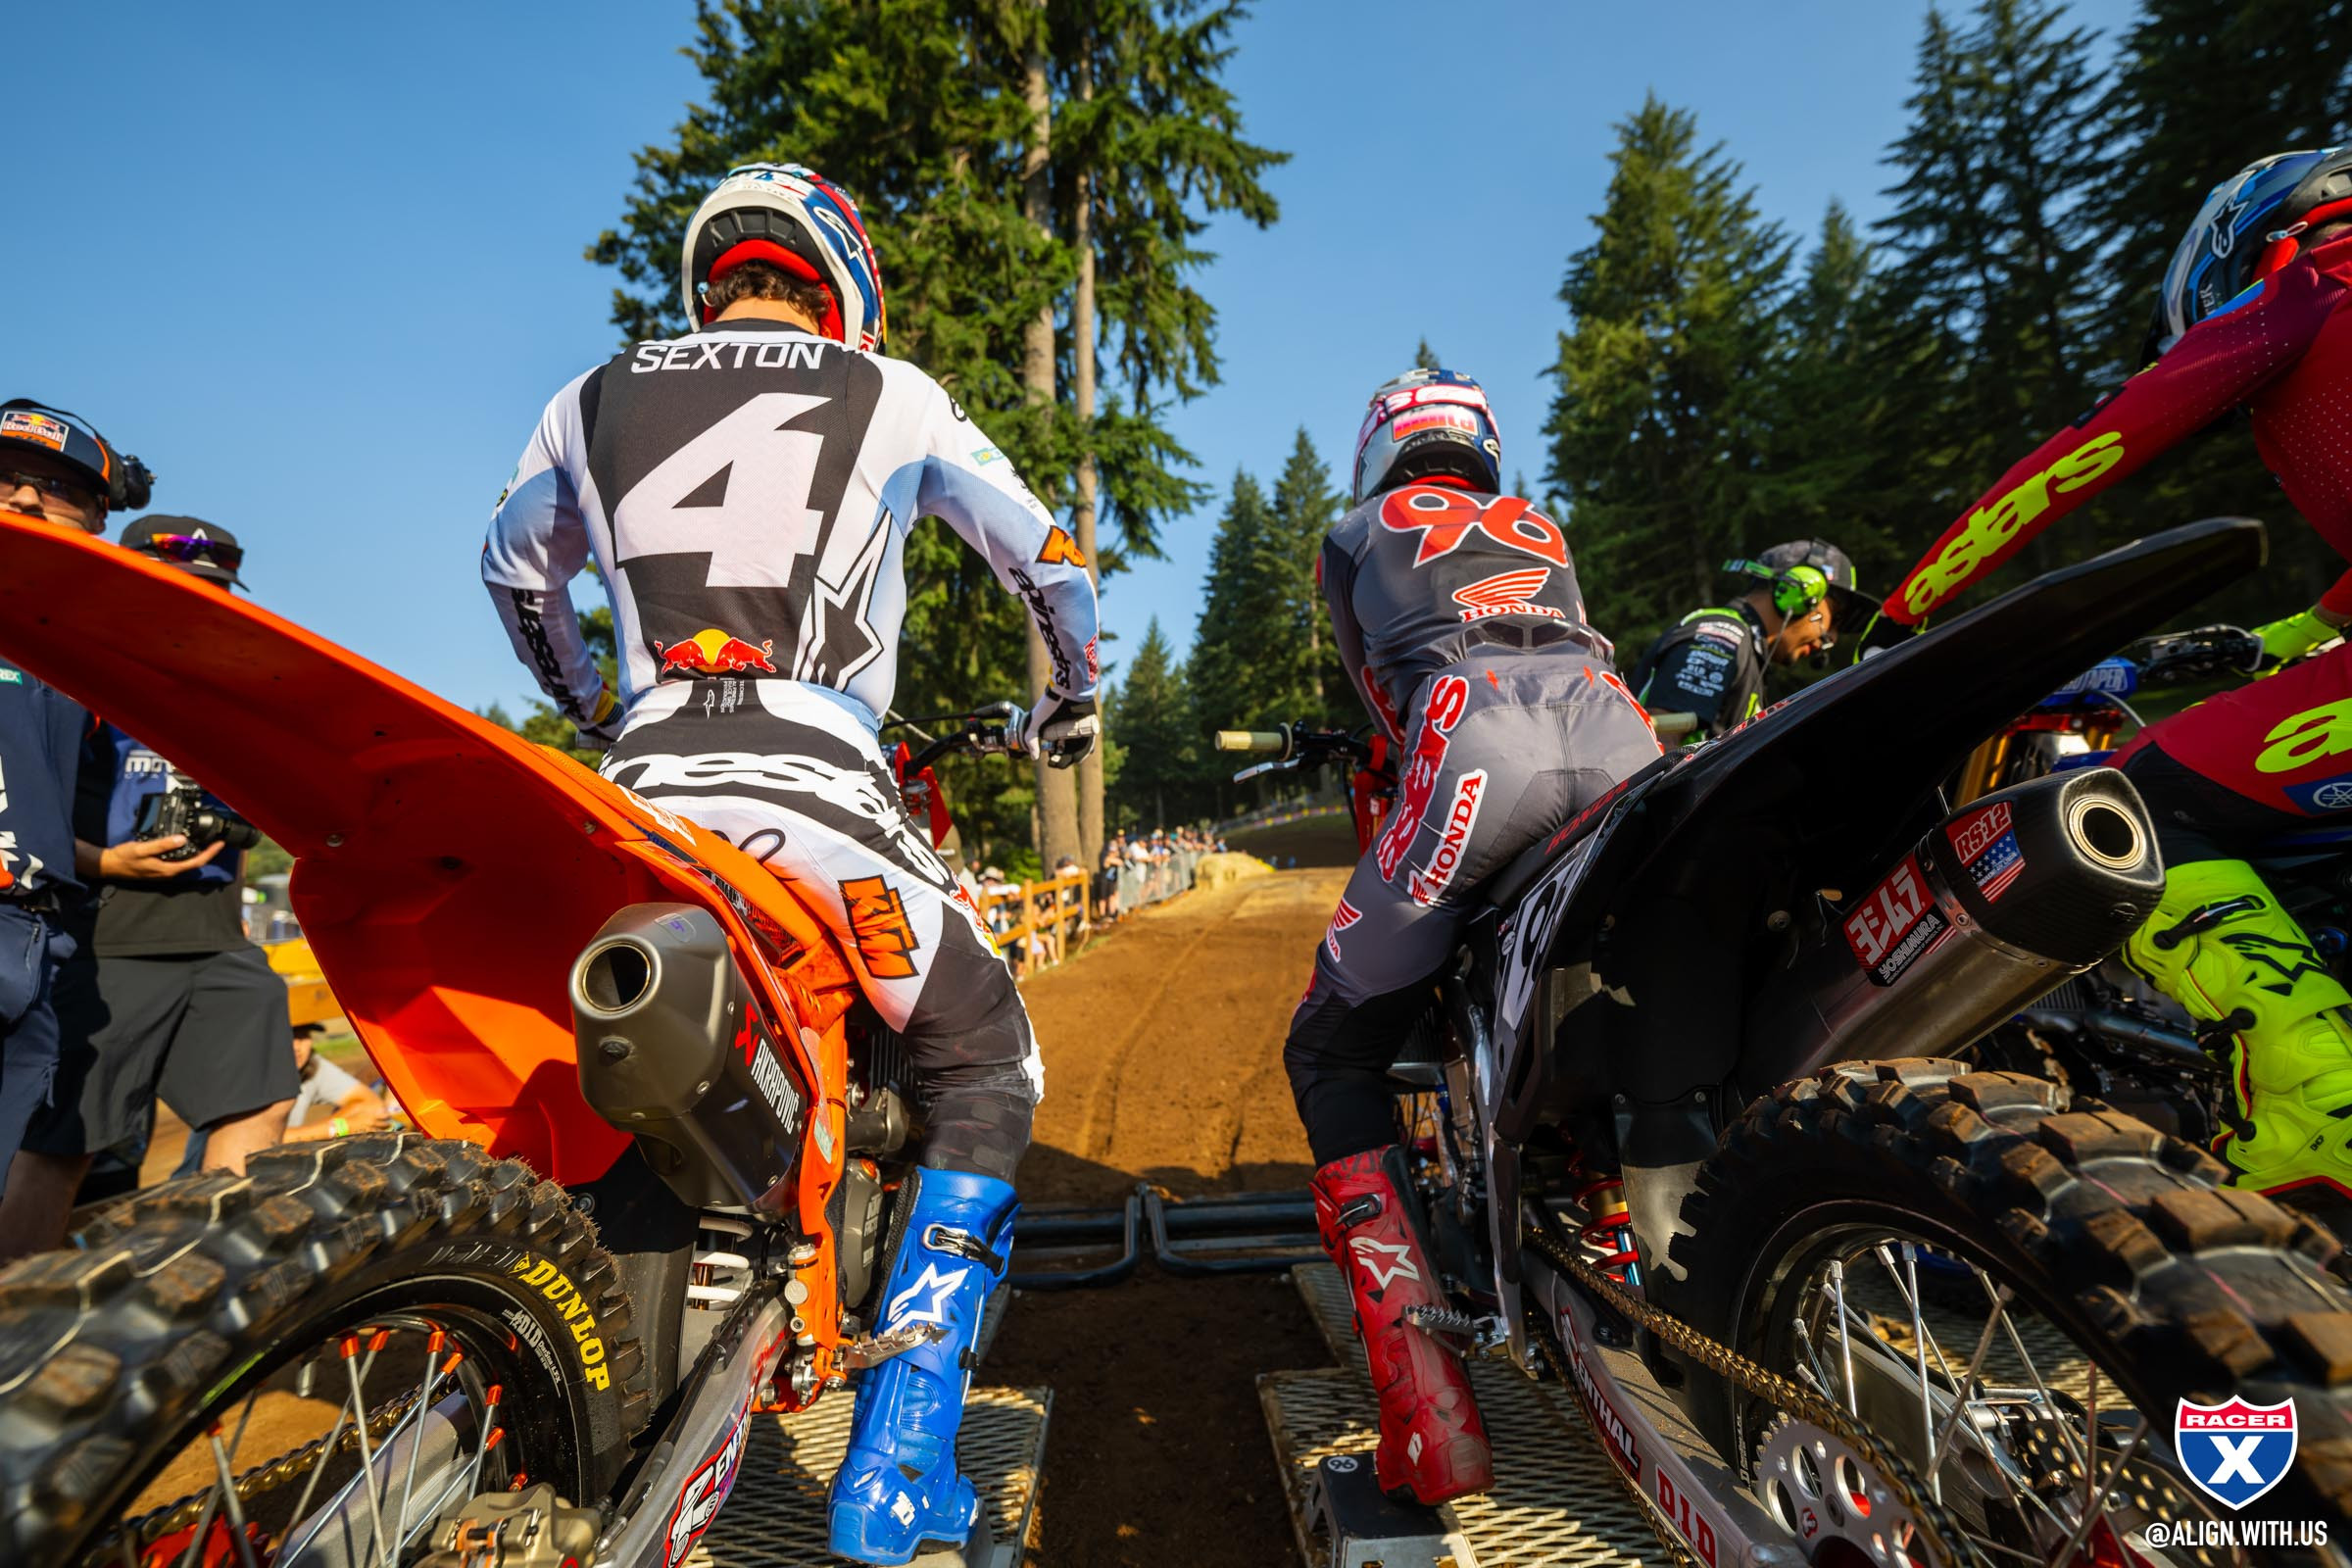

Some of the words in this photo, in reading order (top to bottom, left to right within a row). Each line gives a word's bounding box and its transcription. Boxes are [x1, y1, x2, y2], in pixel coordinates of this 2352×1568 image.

[630, 342, 825, 374] SEXTON
[614, 392, 834, 588] 4
[1379, 485, 1569, 569] 96
[1904, 431, 2126, 615] astars
[1458, 603, 1566, 623] HONDA
[1425, 775, 1482, 890] HONDA
[838, 874, 920, 979] KTM
[1878, 913, 1941, 980] YOSHIMURA
[518, 1259, 611, 1392] DUNLOP
[1330, 1458, 1355, 1470] 96
[1657, 1467, 1716, 1568] D.I.D
